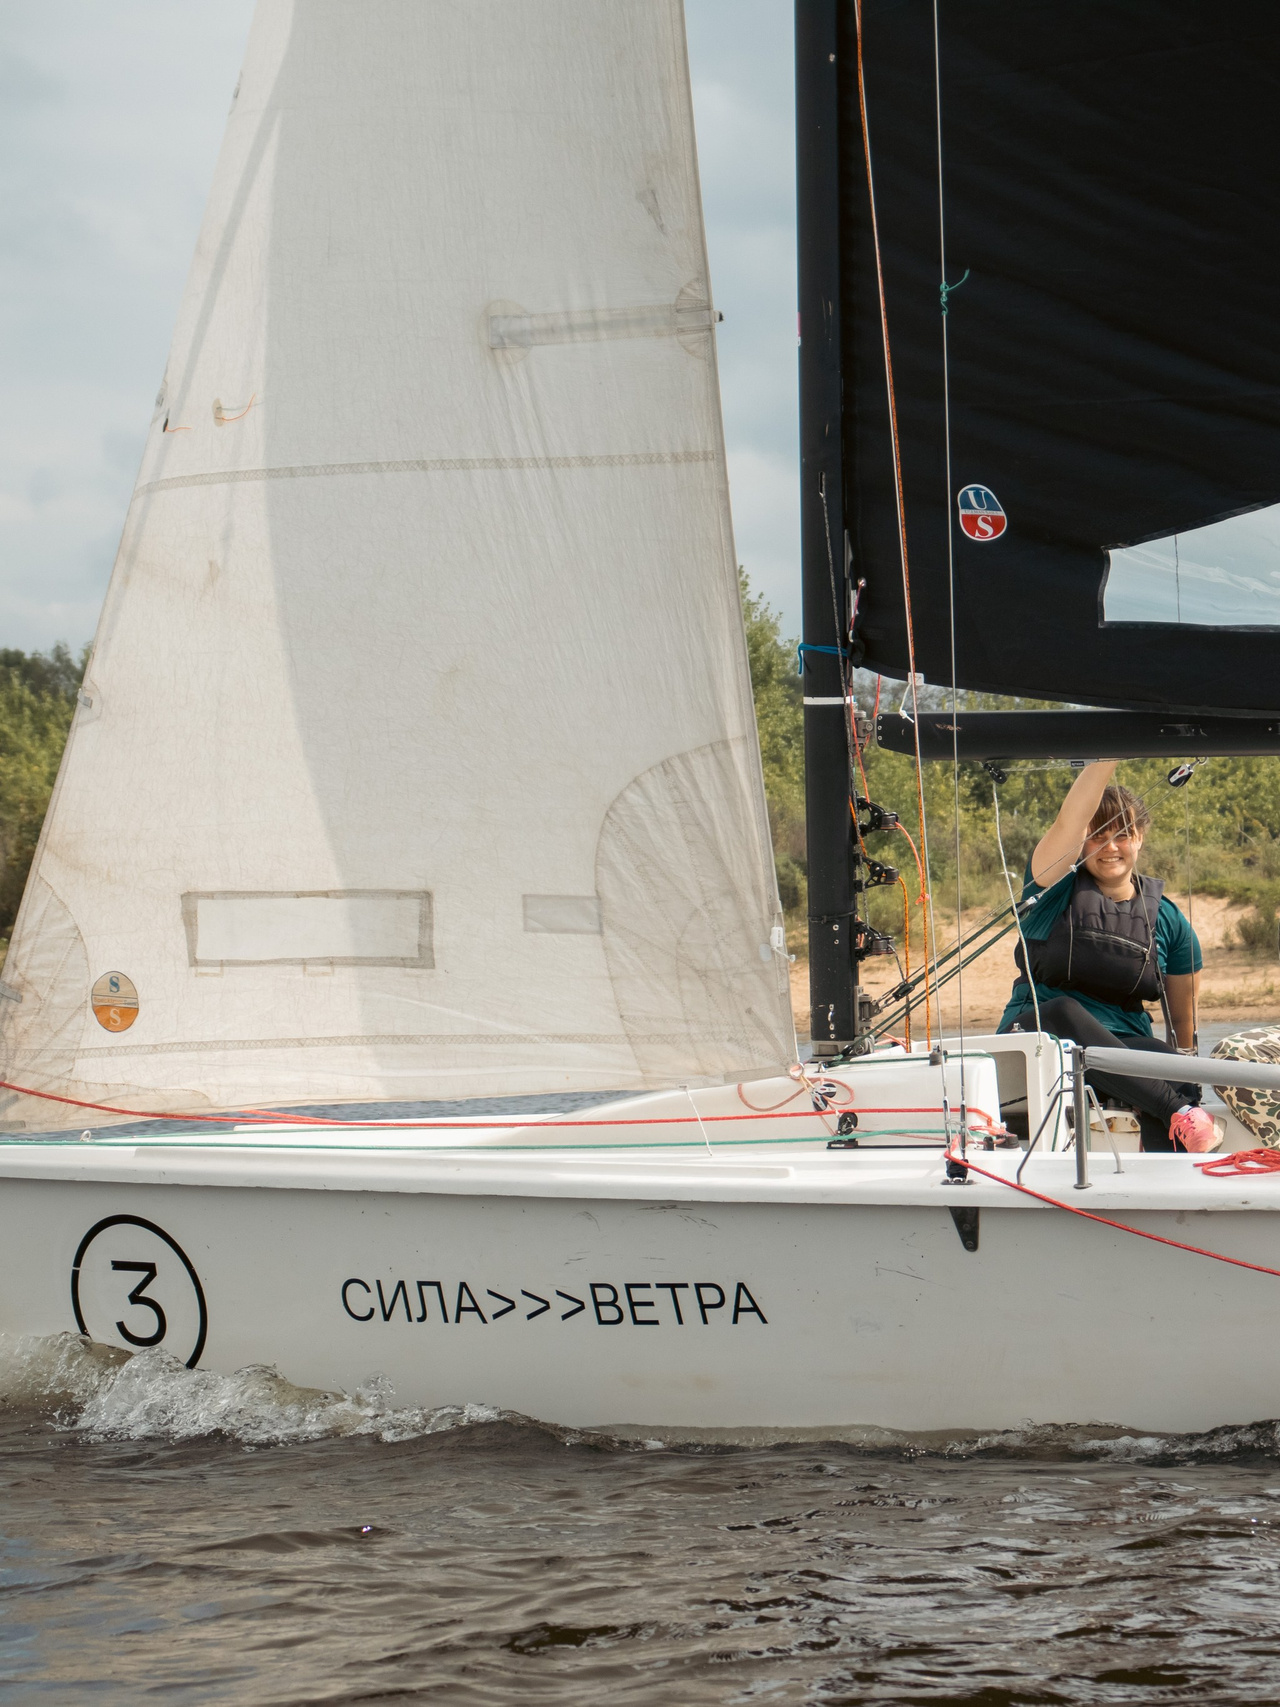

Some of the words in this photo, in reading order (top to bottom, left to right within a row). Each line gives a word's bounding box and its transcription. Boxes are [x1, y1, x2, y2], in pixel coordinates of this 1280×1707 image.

[966, 489, 988, 510] U
[974, 515, 994, 538] S
[109, 975, 120, 993] S
[109, 1008, 121, 1026] S
[111, 1260, 167, 1347] 3
